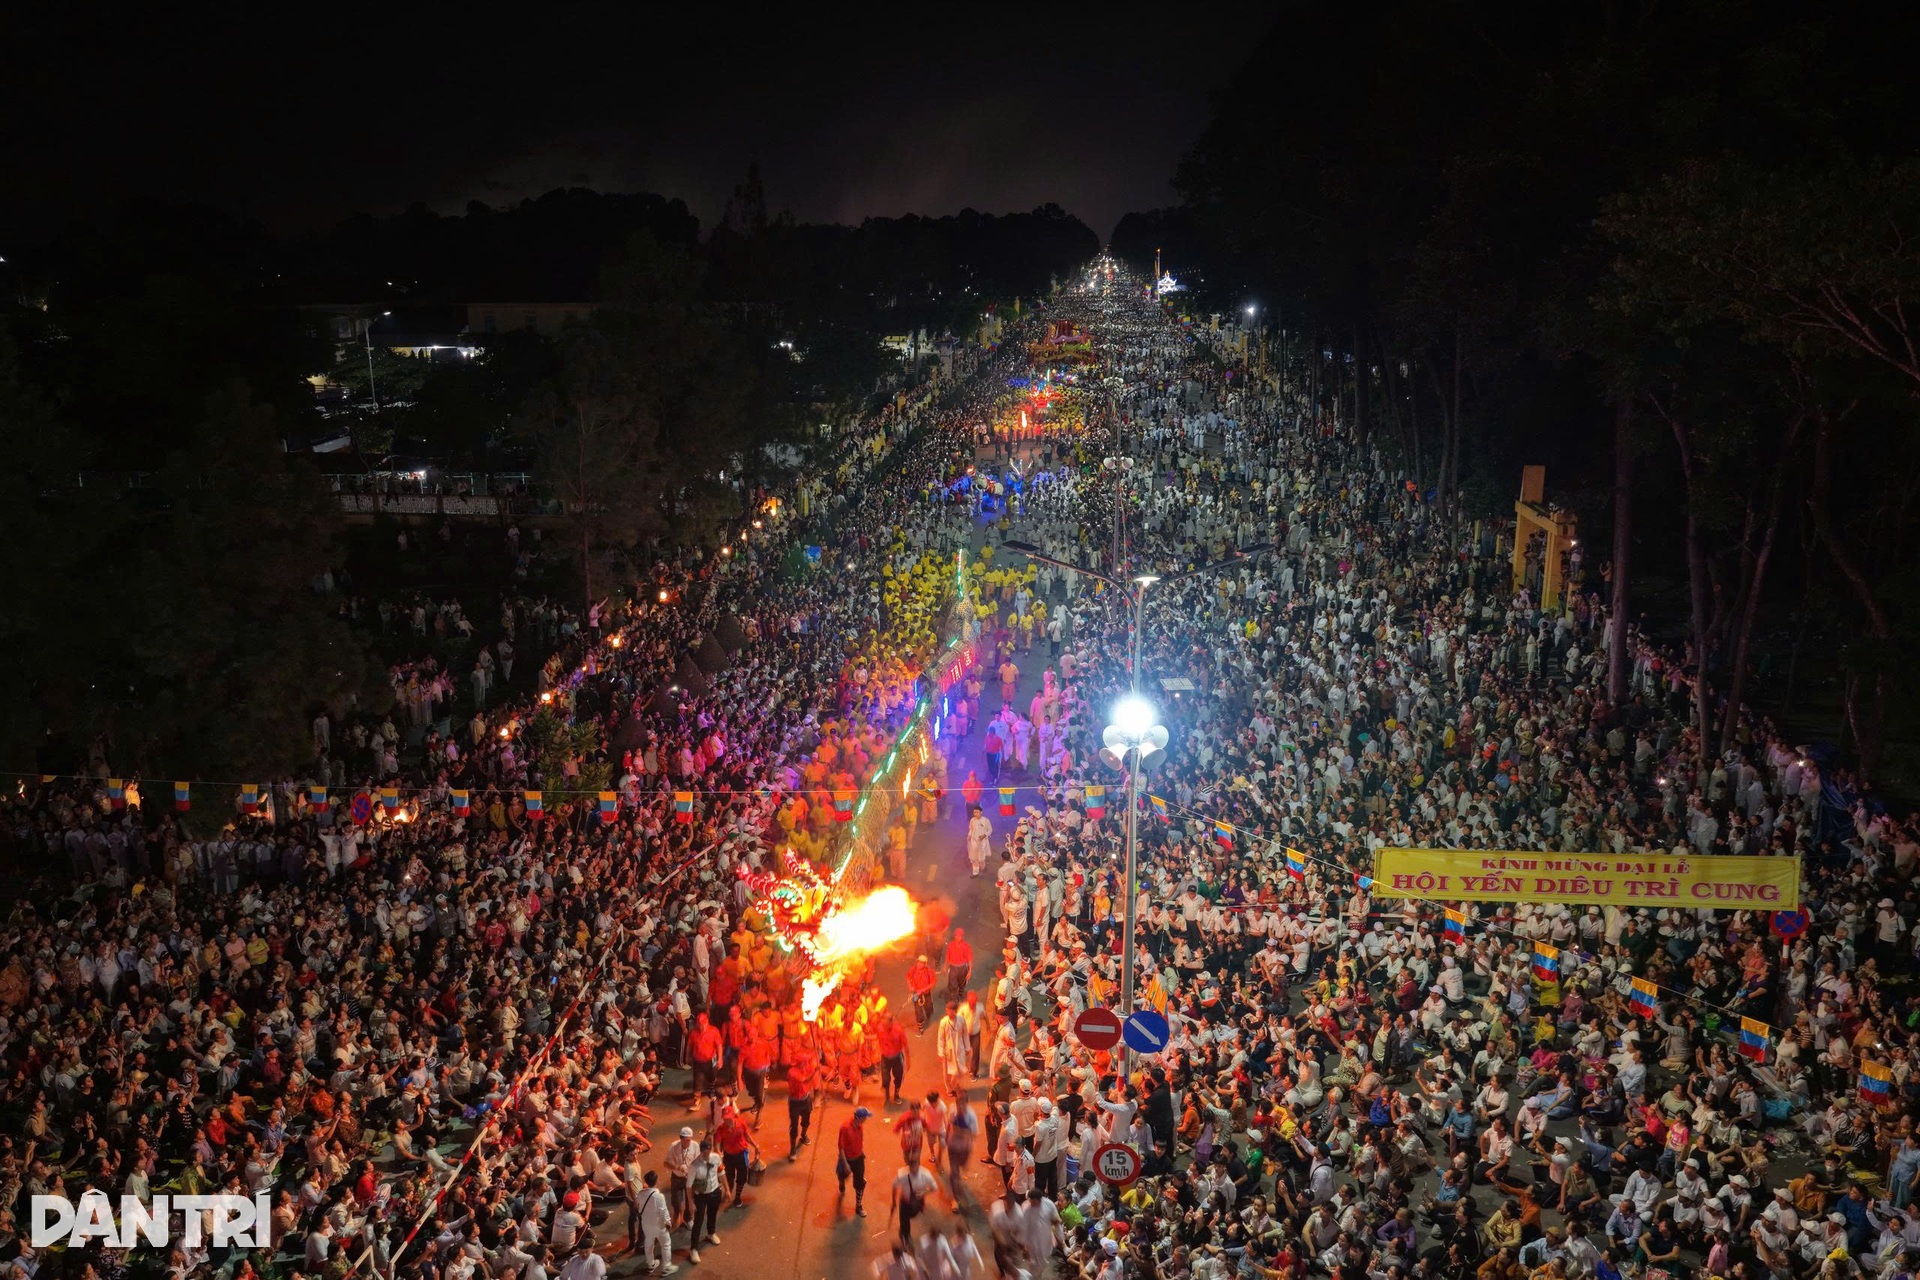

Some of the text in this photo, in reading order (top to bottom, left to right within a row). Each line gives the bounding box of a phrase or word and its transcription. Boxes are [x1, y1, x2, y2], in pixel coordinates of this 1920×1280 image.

[1481, 857, 1537, 870] KÍNH
[1544, 858, 1608, 872] MỪNG
[1663, 858, 1690, 874] LỄ
[1391, 870, 1781, 901] HỘI YẾN DIÊU TRÌ CUNG
[1106, 1151, 1126, 1164] 15
[1104, 1165, 1129, 1176] km/h
